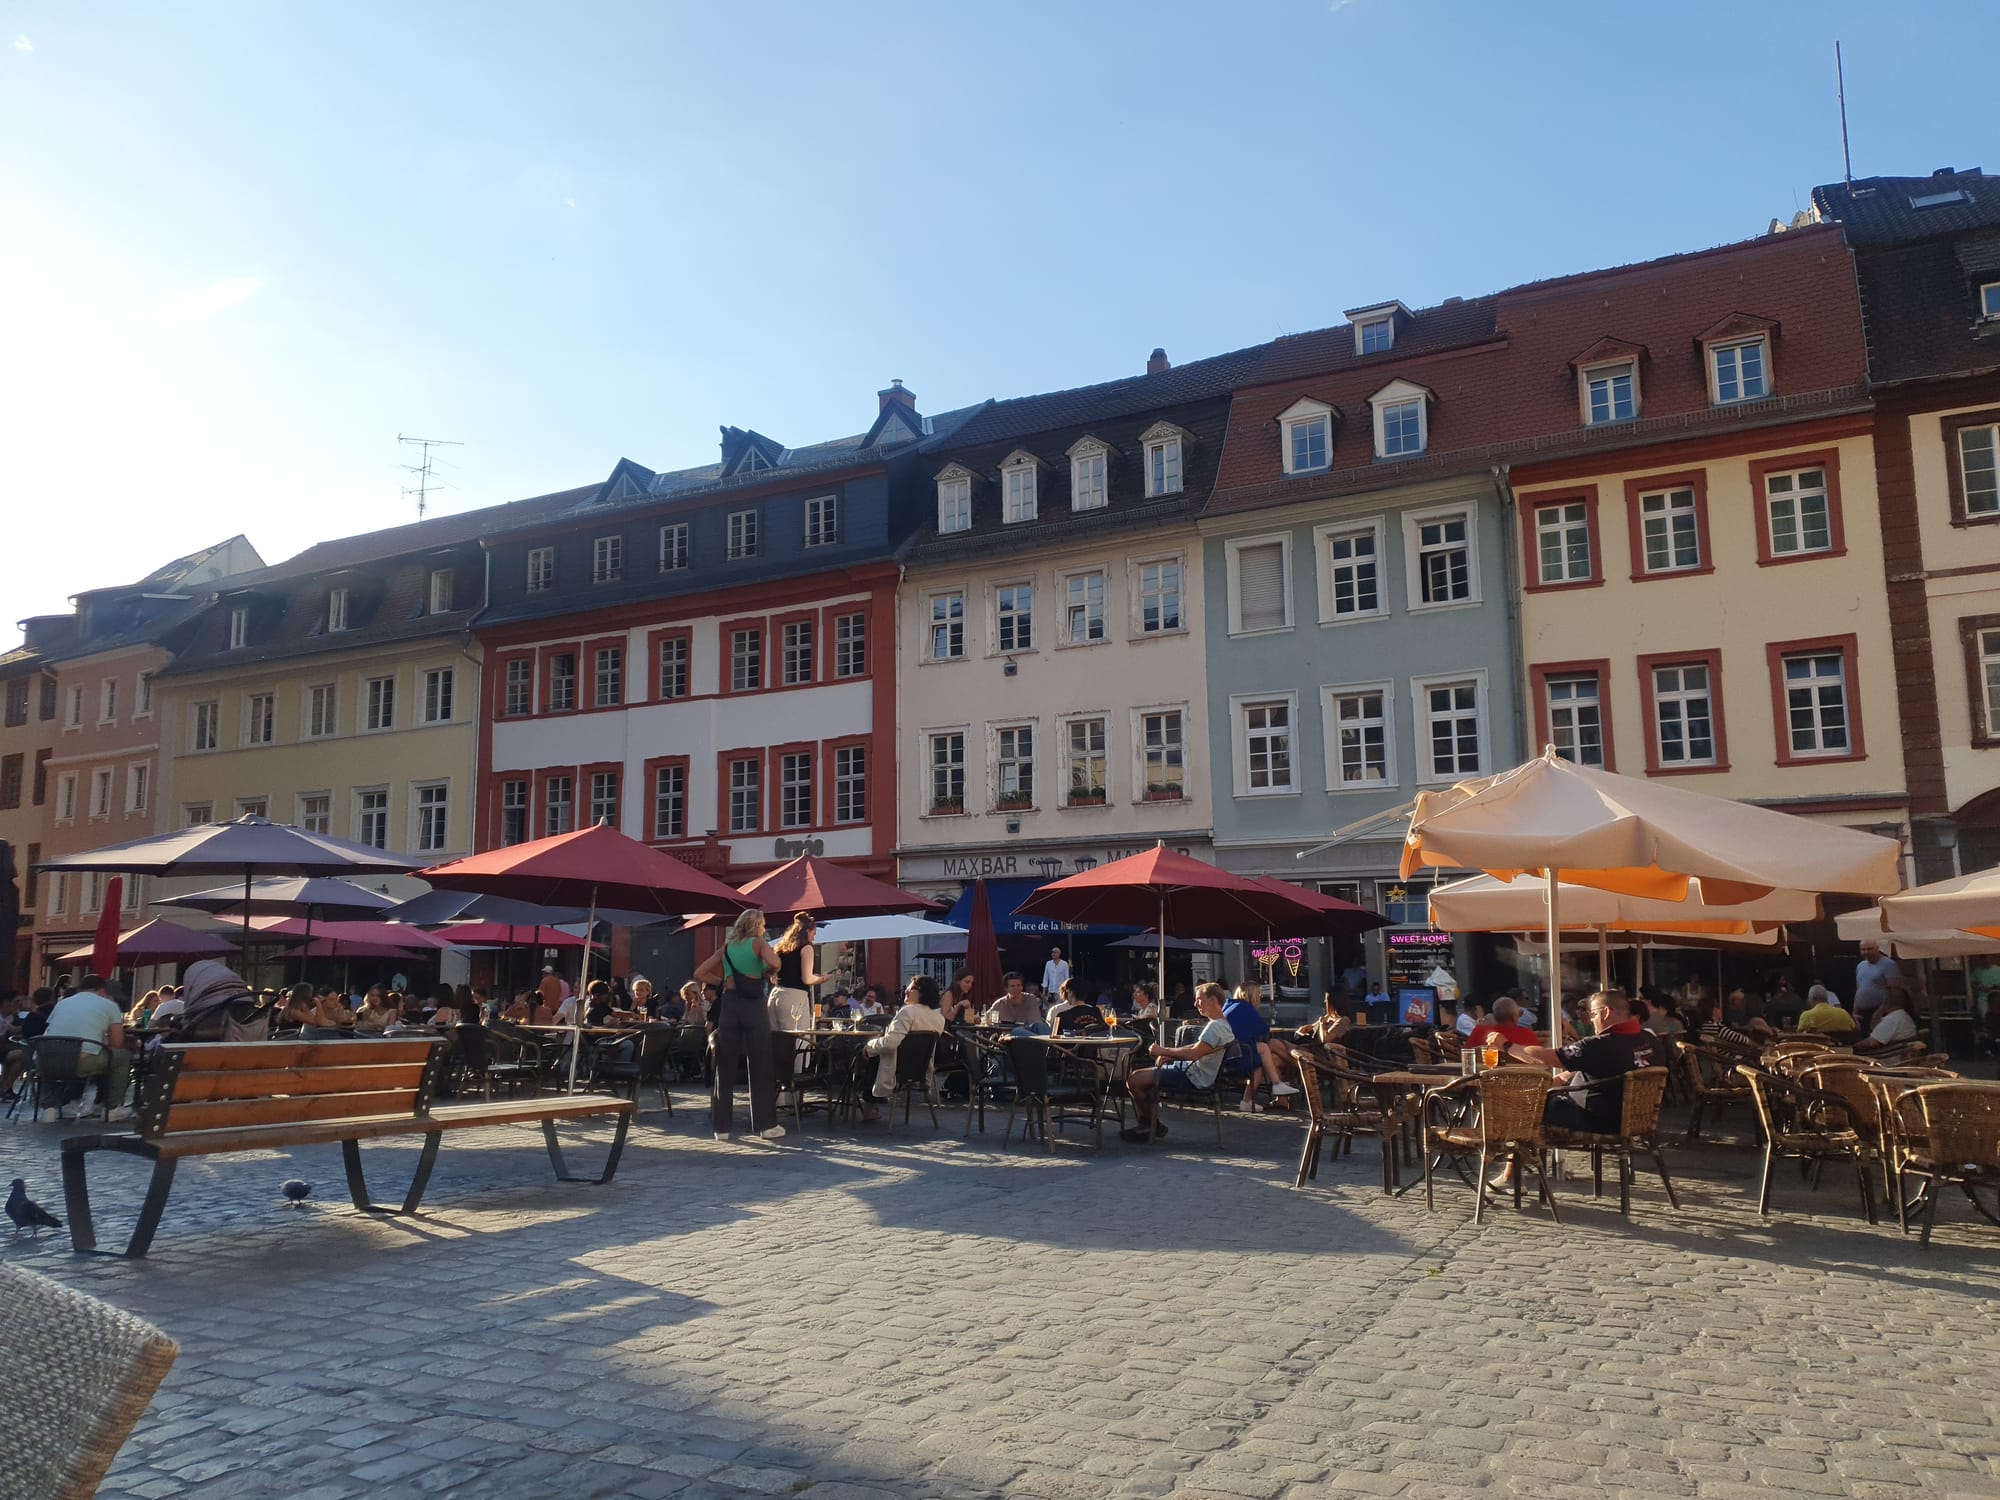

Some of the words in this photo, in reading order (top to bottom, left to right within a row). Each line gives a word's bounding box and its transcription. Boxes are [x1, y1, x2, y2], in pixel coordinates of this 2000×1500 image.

[1014, 921, 1036, 930] Place
[1038, 921, 1048, 930] de
[1051, 921, 1058, 930] la
[1391, 935, 1420, 943] SWEET
